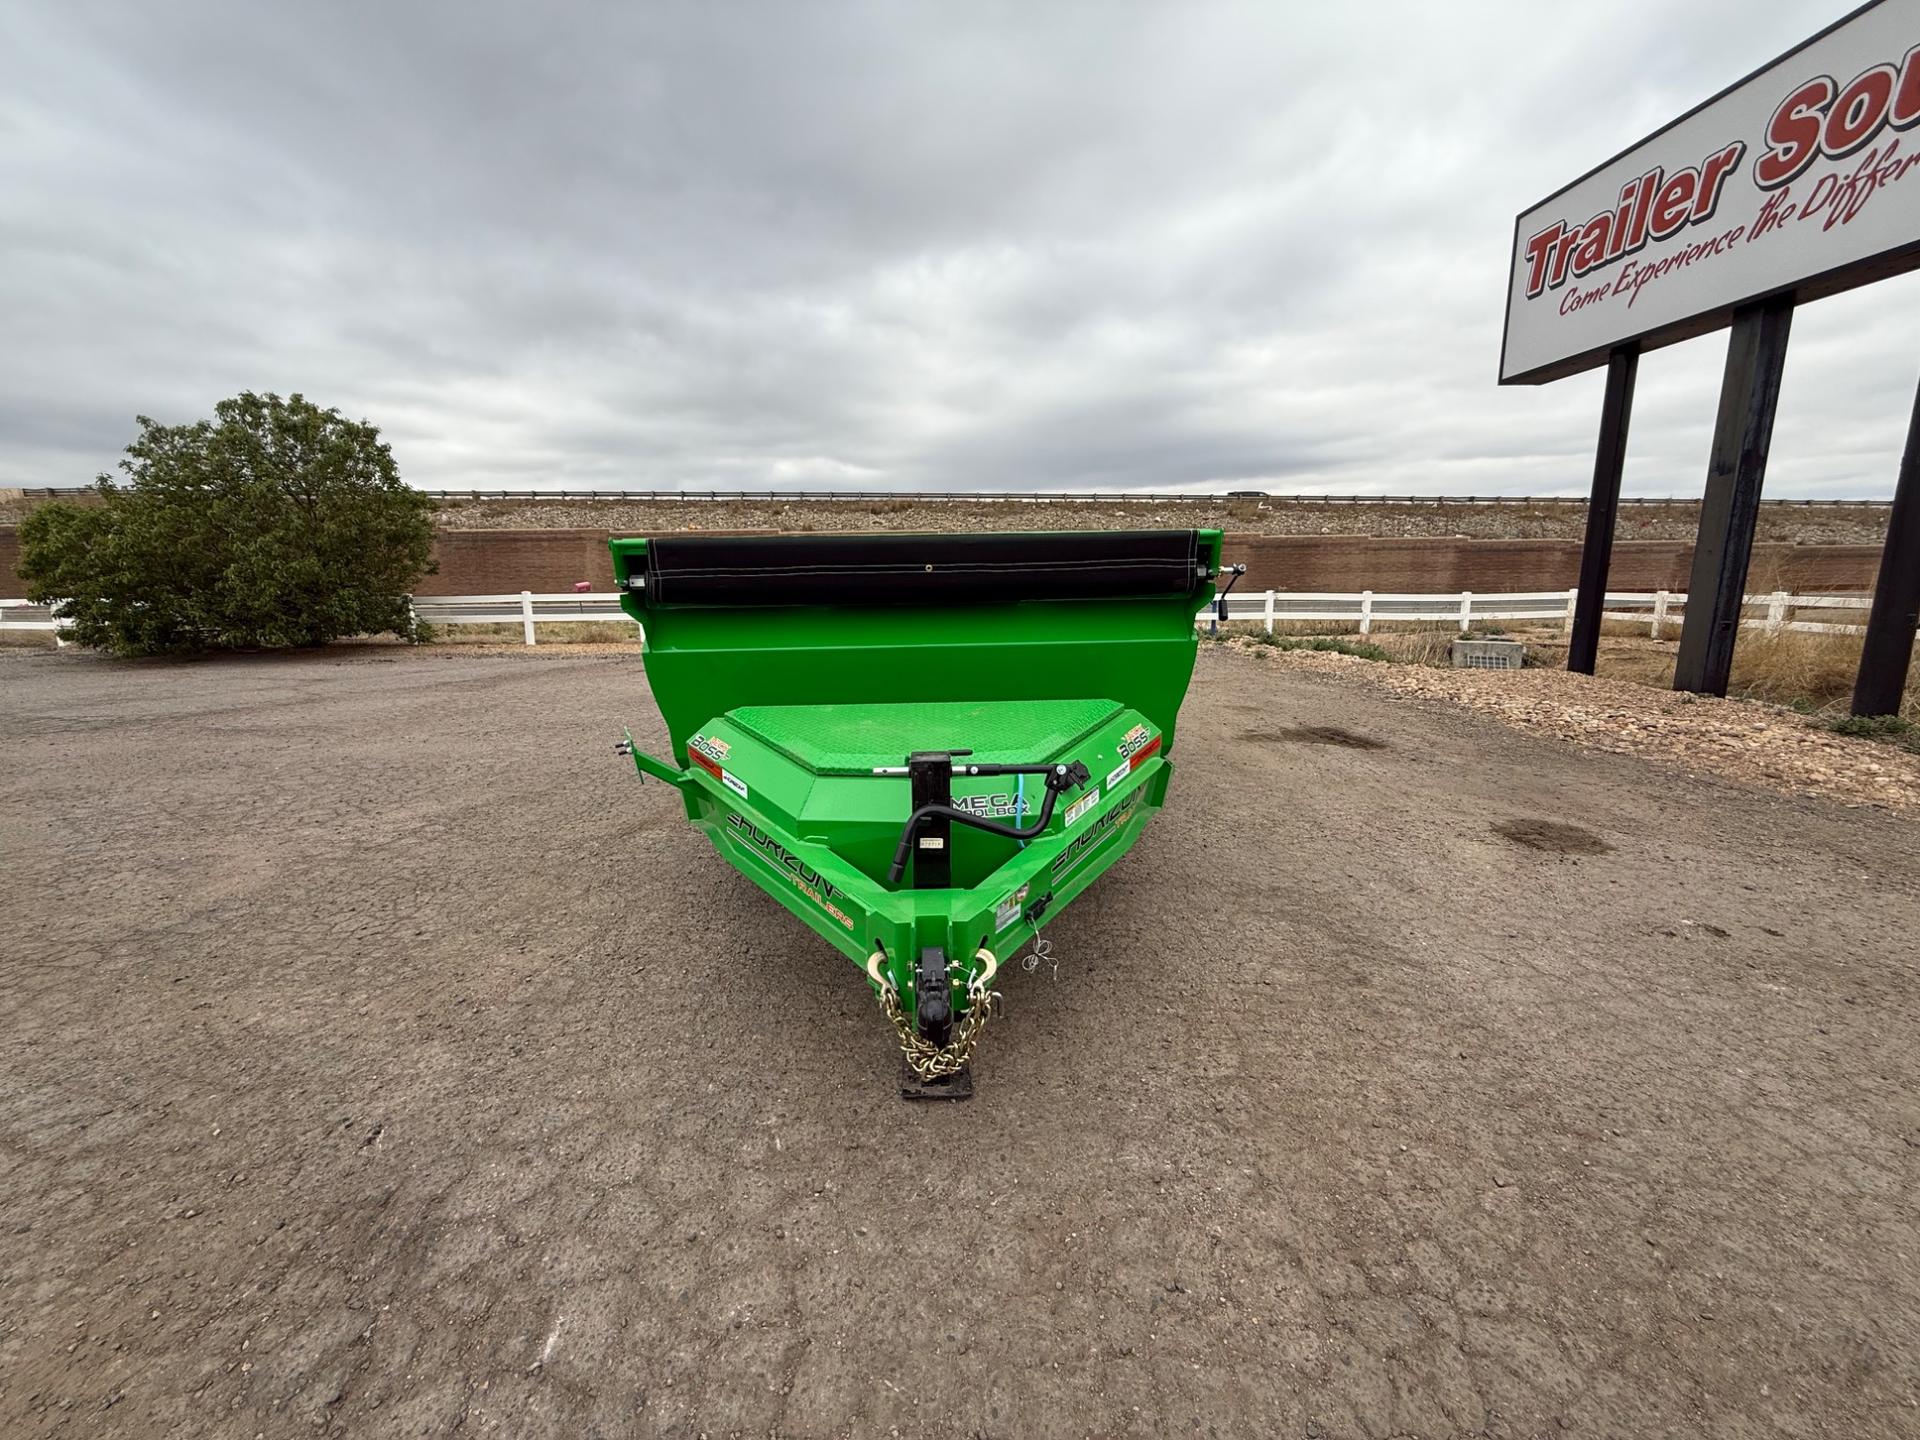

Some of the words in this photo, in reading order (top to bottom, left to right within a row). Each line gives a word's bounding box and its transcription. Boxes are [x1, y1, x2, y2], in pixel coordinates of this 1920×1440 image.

[1525, 141, 1746, 300] Trailer
[1559, 278, 1610, 316] Come
[1611, 225, 1745, 309] Experience
[1746, 186, 1798, 243] the
[690, 735, 724, 761] BOSS
[1119, 730, 1149, 759] BOSS
[951, 793, 1028, 809] MEGA
[790, 872, 854, 931] TRAILERS
